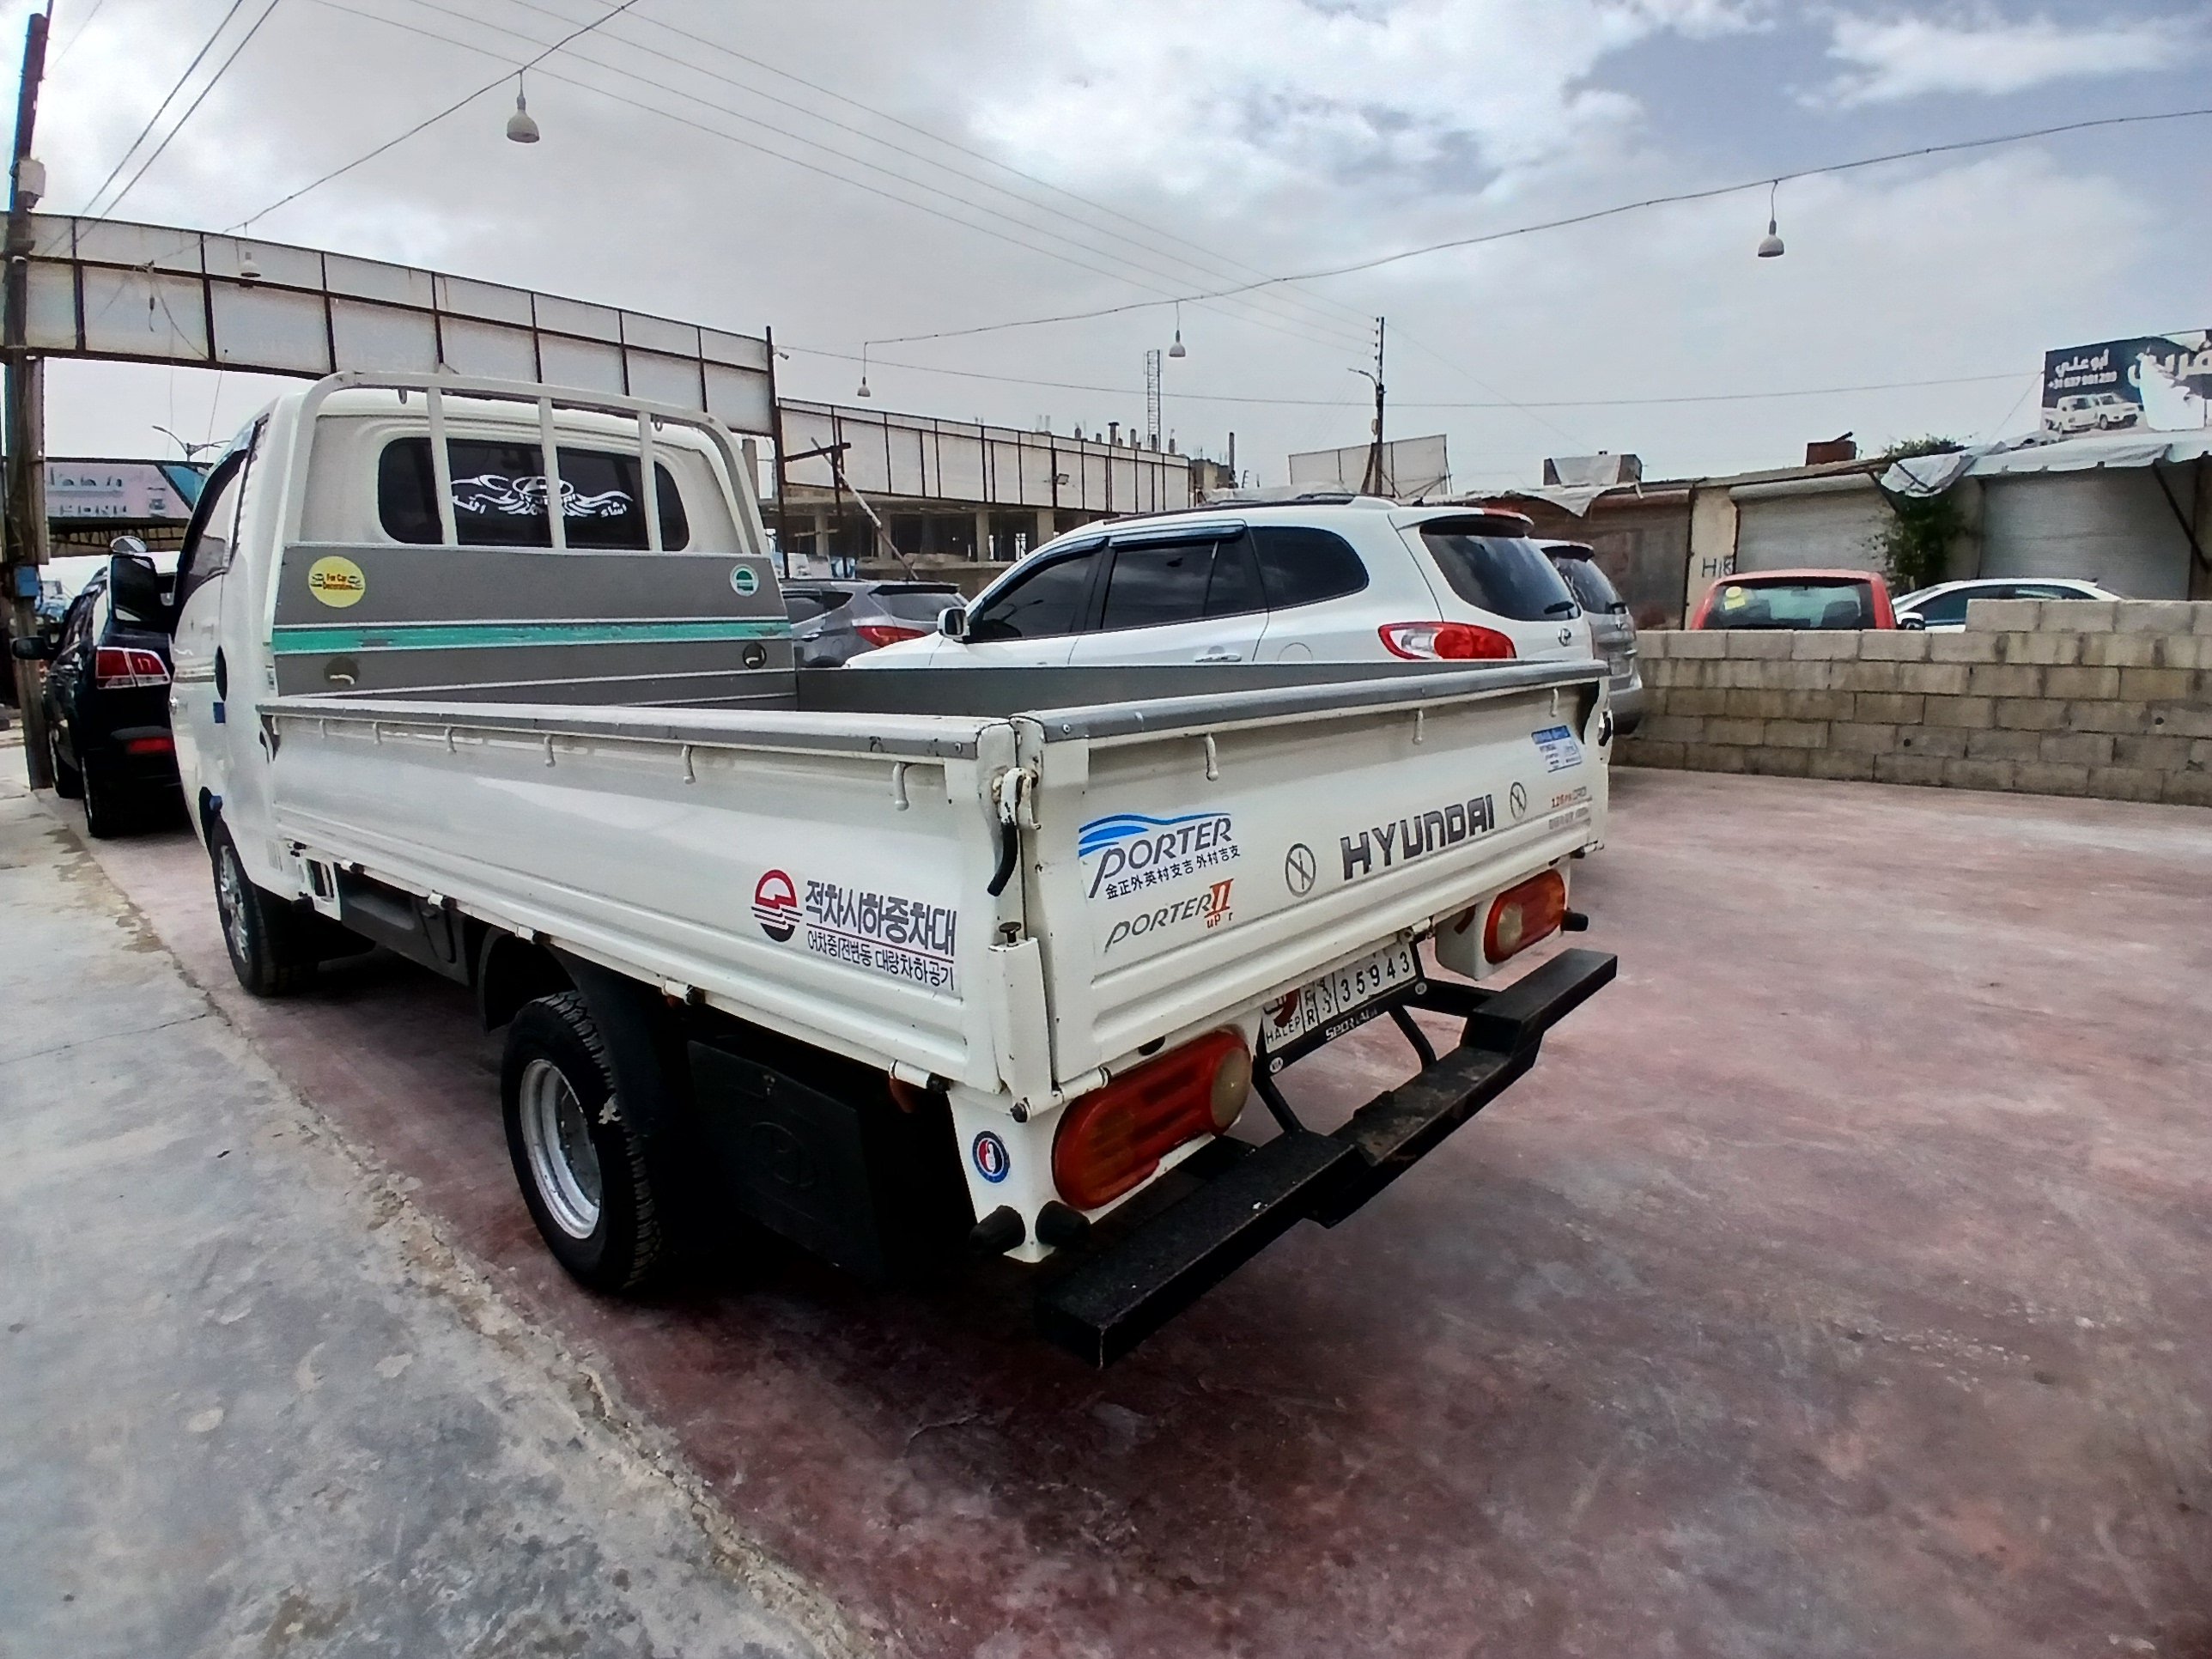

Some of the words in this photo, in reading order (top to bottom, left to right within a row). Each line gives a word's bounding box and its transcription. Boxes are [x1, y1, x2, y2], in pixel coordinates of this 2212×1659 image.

[1088, 817, 1232, 899] PORTER
[1340, 794, 1495, 881] HYUNDAI
[1103, 892, 1212, 954] PORTER
[1340, 951, 1411, 1003] 35943
[1266, 1016, 1302, 1045] HALEP
